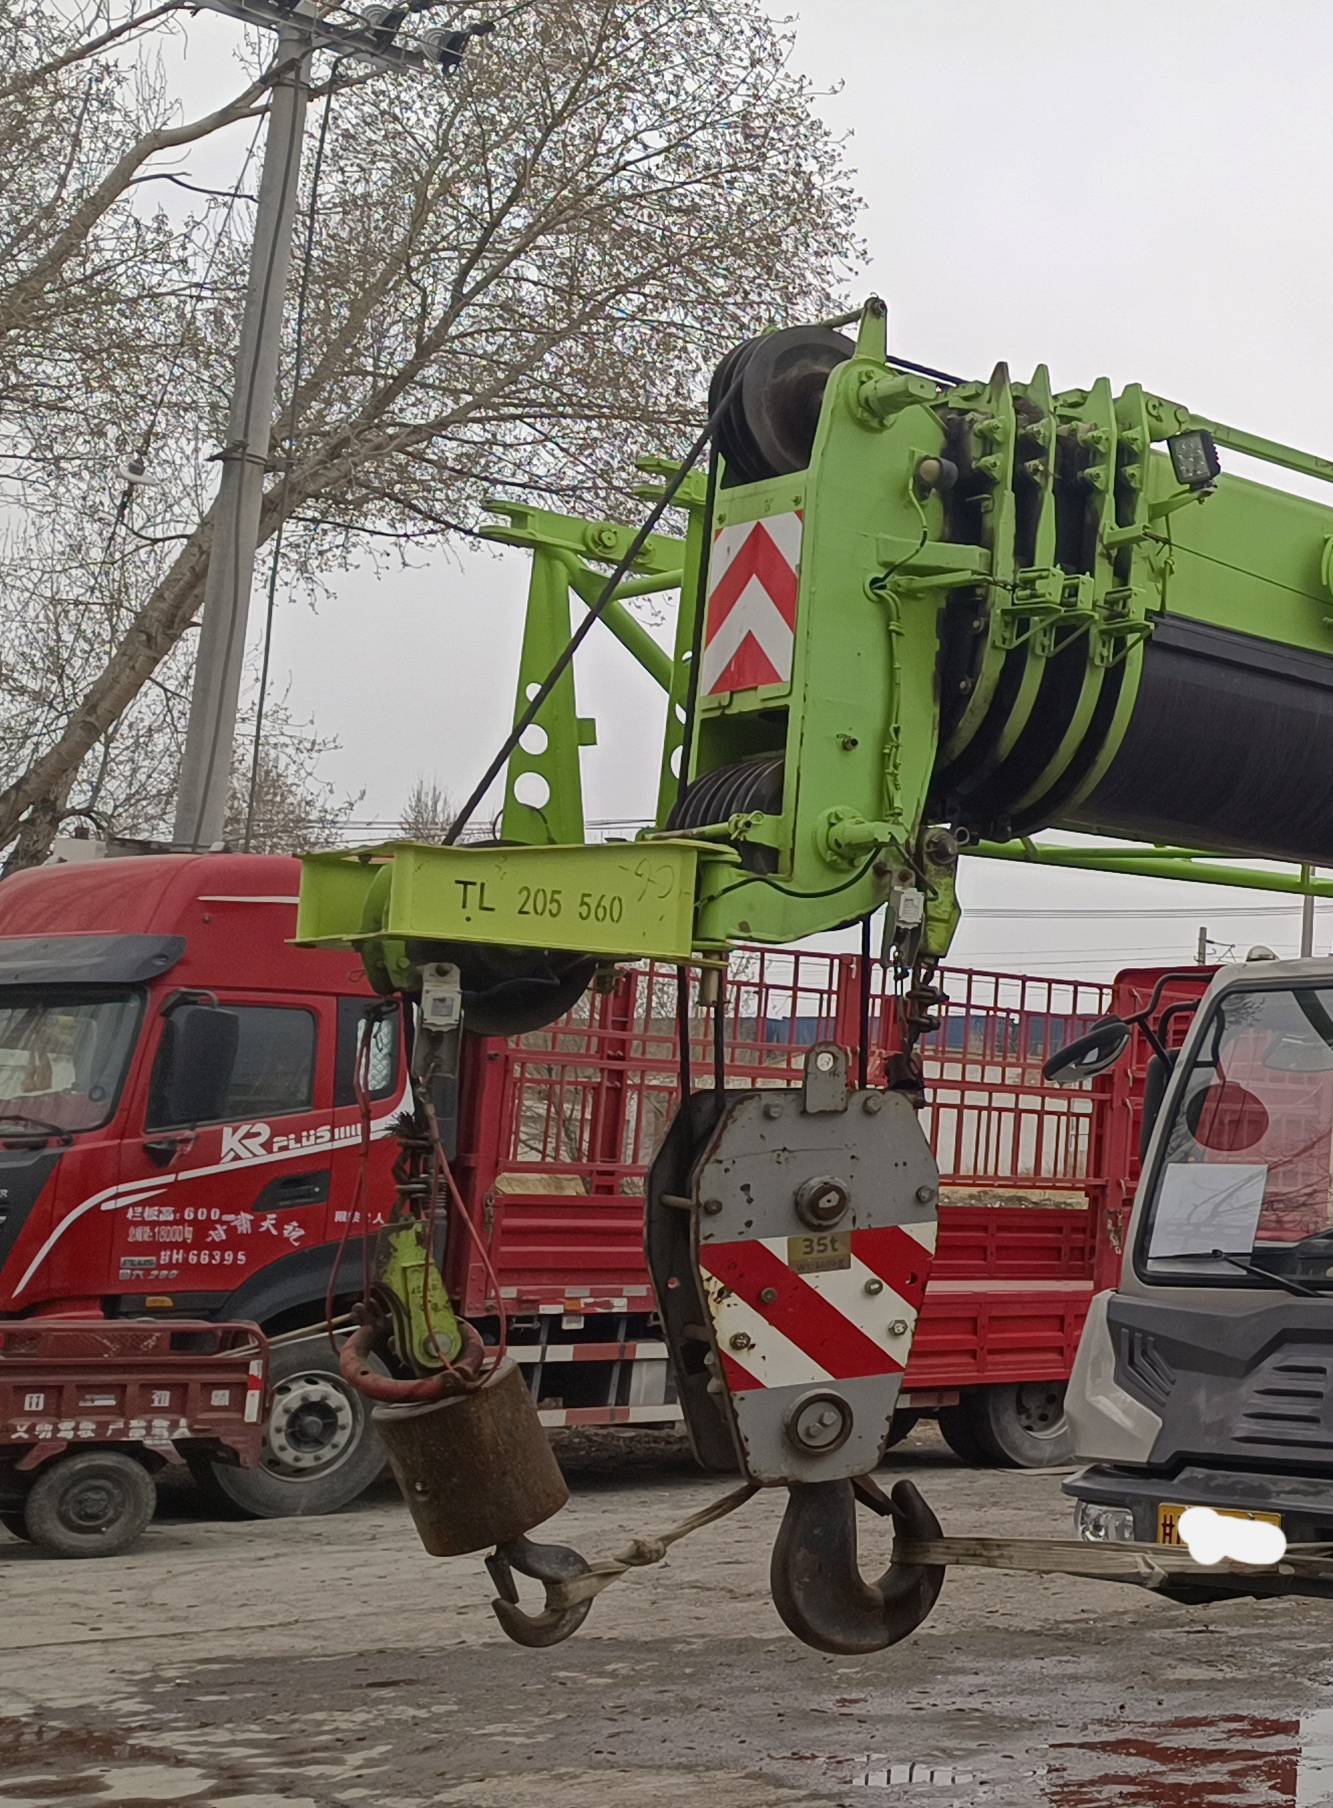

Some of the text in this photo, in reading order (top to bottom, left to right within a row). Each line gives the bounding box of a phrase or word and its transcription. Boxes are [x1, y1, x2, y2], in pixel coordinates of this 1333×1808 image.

[454, 879, 623, 924] TL 205 560
[220, 1122, 331, 1164] KR PLUS
[802, 1234, 839, 1255] 35t
